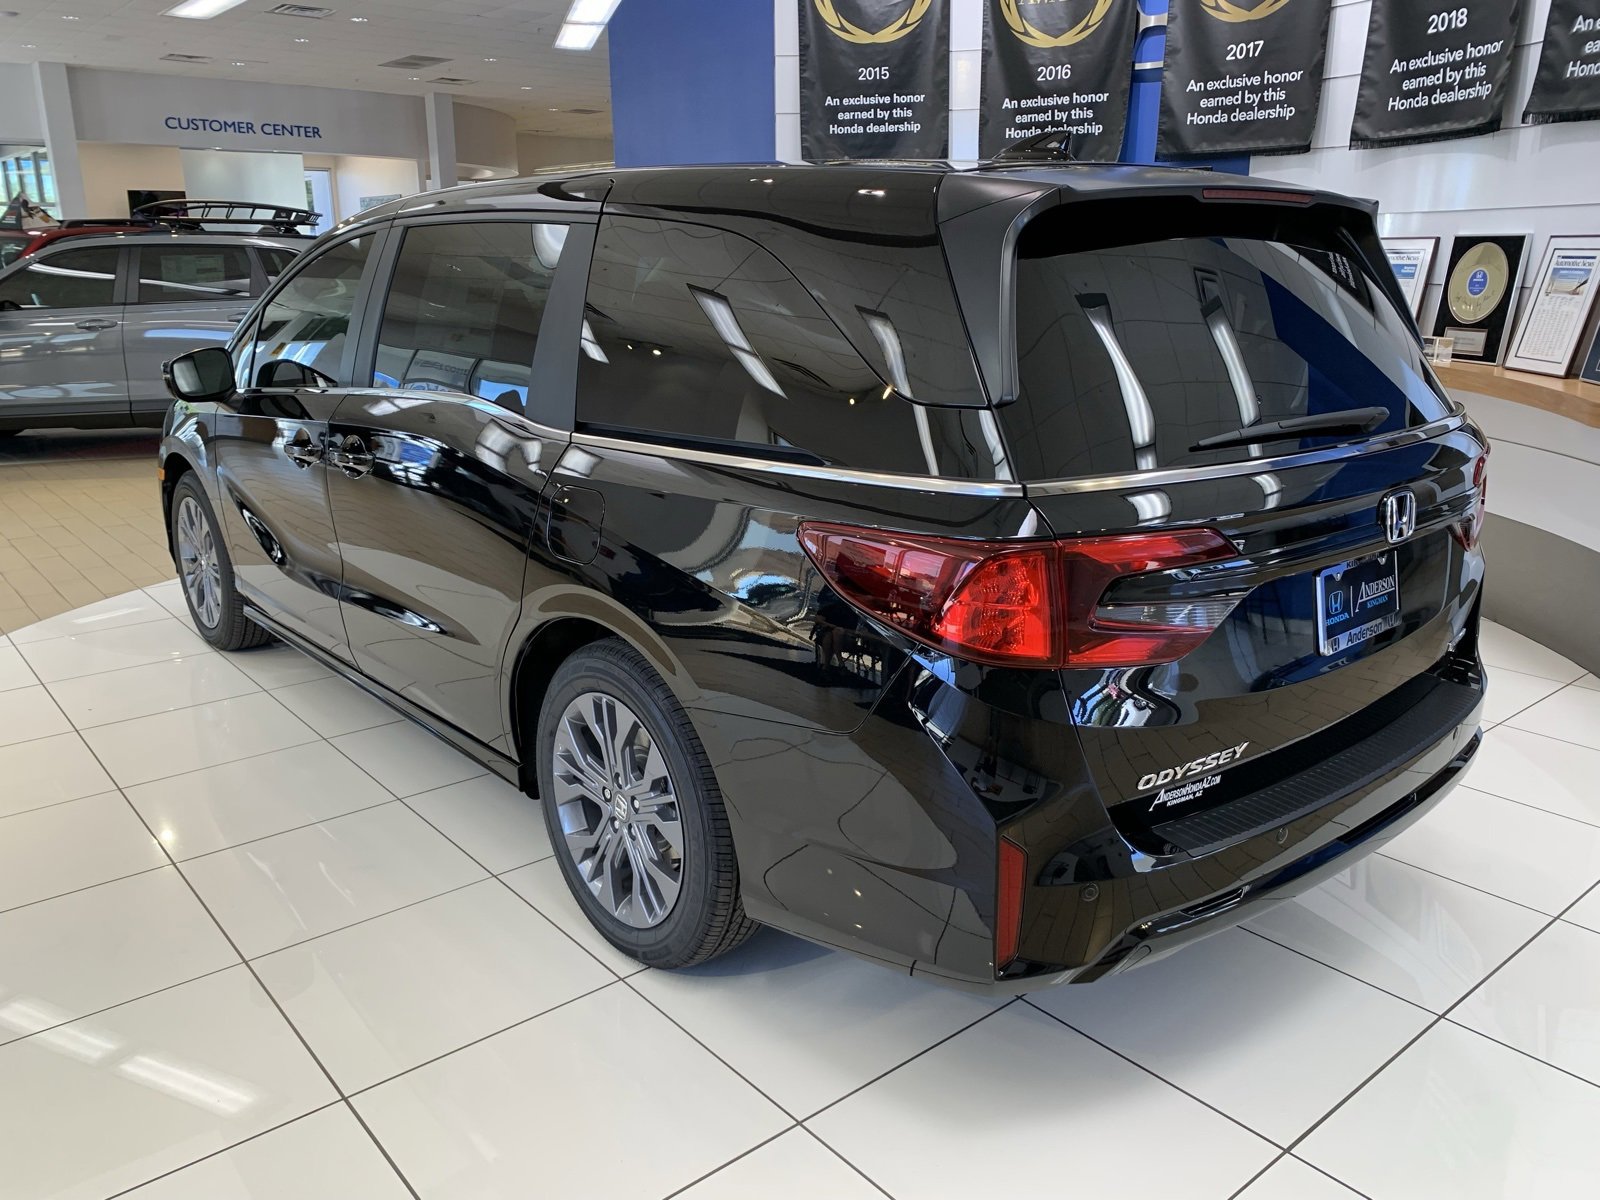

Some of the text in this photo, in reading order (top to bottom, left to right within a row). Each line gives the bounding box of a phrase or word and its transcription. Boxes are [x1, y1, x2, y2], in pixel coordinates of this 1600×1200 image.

[1427, 8, 1468, 34] 2018
[1572, 15, 1593, 32] An
[1226, 40, 1264, 60] 2017
[1390, 40, 1504, 74] An exclusive honor
[858, 67, 890, 80] 2015
[1037, 65, 1071, 81] 2016
[1186, 70, 1303, 92] An exclusive honor
[1402, 62, 1487, 91] earned by this
[824, 93, 925, 106] An exclusive honor
[1002, 92, 1109, 109] An exclusive honor
[1200, 88, 1286, 108] earned by this
[1388, 81, 1492, 111] Honda dealership
[837, 107, 913, 120] earned by this
[1015, 107, 1094, 124] earned by this
[1186, 104, 1296, 125] Honda dealership
[164, 116, 323, 139] CUSTOMER CENTER
[829, 122, 921, 135] Honda dealership
[1005, 126, 1042, 139] Honda
[1355, 574, 1395, 613] ANDERSON
[1326, 611, 1350, 626] HONDA
[1346, 619, 1383, 646] Anderson
[1137, 741, 1250, 790] ODYSSEY
